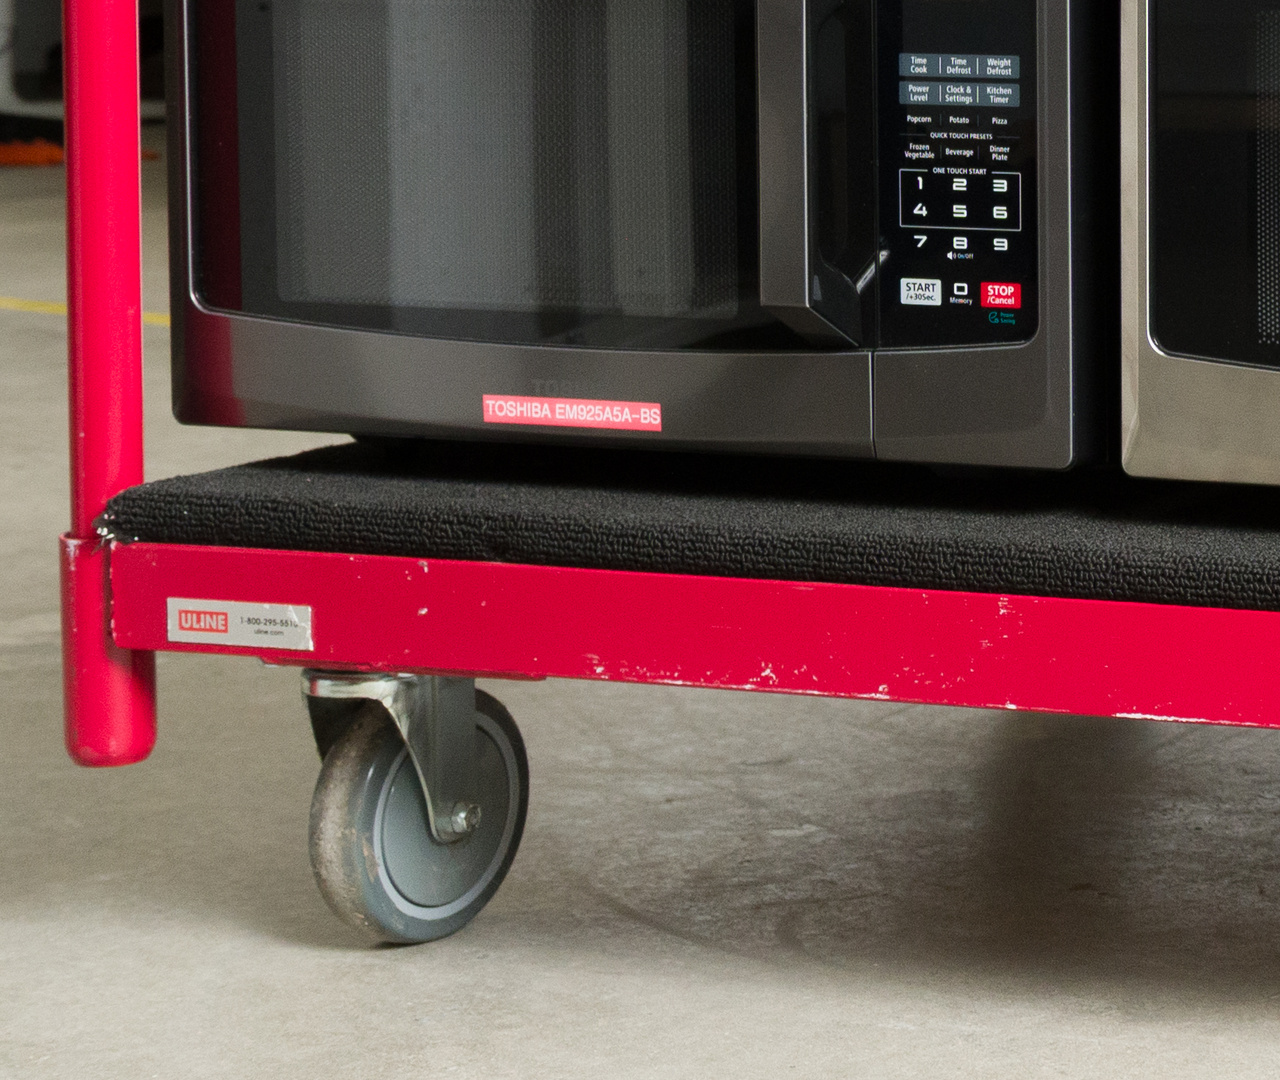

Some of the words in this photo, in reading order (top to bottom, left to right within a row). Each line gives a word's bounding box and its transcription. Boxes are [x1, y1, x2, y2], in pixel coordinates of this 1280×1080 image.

[911, 56, 927, 65] Time
[950, 57, 967, 66] Time
[987, 58, 1011, 68] Weight
[910, 65, 928, 74] Cook
[946, 66, 971, 75] Defrost
[986, 67, 1012, 76] Defrost
[908, 84, 929, 93] Power
[946, 85, 965, 94] Clock
[965, 86, 972, 94] &
[986, 86, 1012, 95] Kitchen
[910, 93, 928, 102] Level
[945, 94, 973, 105] Settings
[989, 95, 1009, 104] Timer
[907, 115, 932, 124] Popcorn
[949, 116, 970, 124] Potato
[991, 117, 1008, 125] Pizza
[949, 132, 969, 140] TOUCH
[909, 142, 930, 151] Frozen
[989, 145, 1010, 153] Dinner
[904, 150, 935, 160] Vegetable
[945, 148, 974, 157] Beverage
[991, 153, 1008, 161] Plate
[932, 167, 946, 175] ONE
[946, 167, 968, 175] TOUCH
[916, 176, 924, 190] 1
[952, 177, 968, 191] 2
[992, 178, 1008, 192] 3
[913, 203, 928, 217] 4
[952, 204, 968, 218] 5
[992, 206, 1008, 219] 6
[913, 235, 928, 248] 7
[952, 236, 968, 250] 8
[993, 238, 1008, 251] 9
[905, 282, 936, 292] START
[987, 285, 1014, 296] STOP
[949, 297, 973, 306] Memory
[987, 296, 1015, 305] /Cancel
[485, 399, 552, 419] TOSHIBA
[555, 403, 661, 425] EM925A5A-BS
[181, 612, 226, 631] ULINE
[254, 628, 285, 636] uline.com
